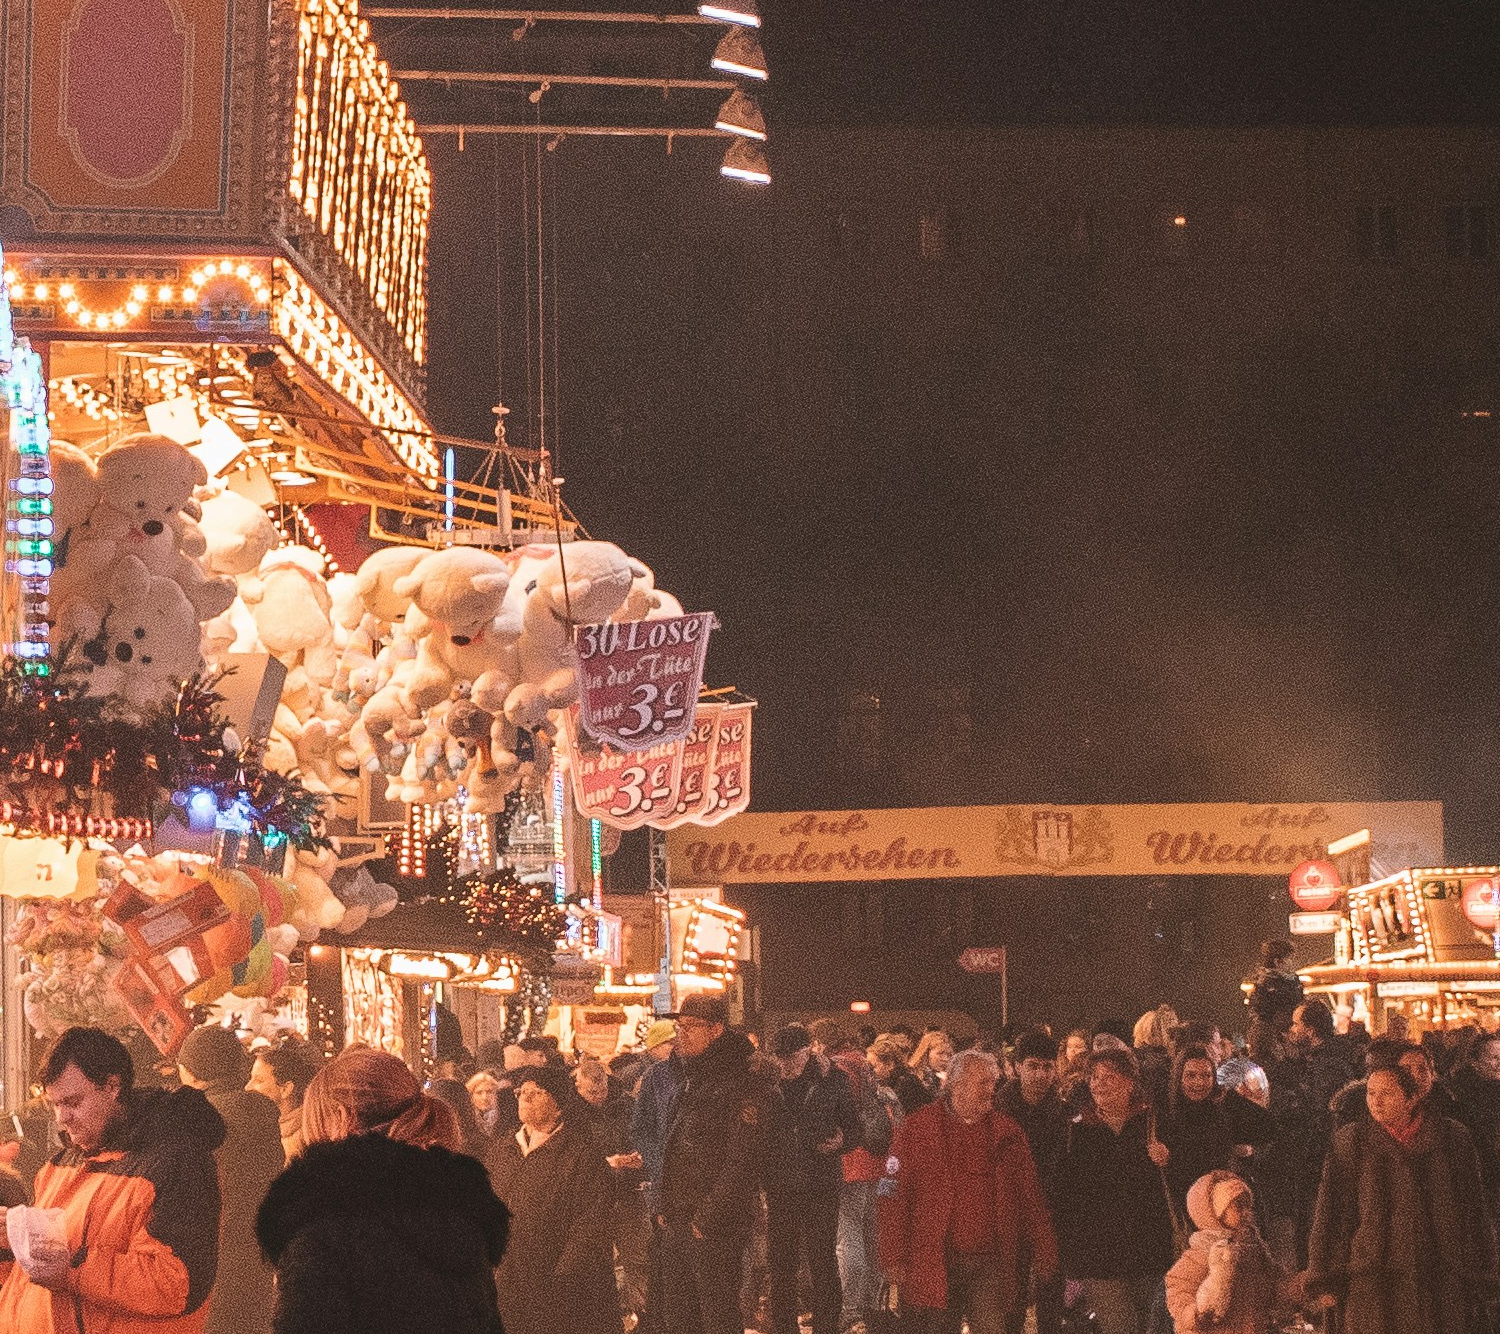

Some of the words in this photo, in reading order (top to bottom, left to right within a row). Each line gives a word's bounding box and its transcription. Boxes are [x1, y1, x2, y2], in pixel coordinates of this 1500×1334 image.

[581, 623, 621, 660] 30
[626, 616, 700, 652] Lose
[607, 665, 637, 686] der
[637, 653, 693, 681] Tüte
[591, 702, 624, 723] nur
[780, 813, 868, 835] Auf
[1240, 805, 1330, 828] Auf
[685, 835, 960, 875] Wiedersehen
[969, 952, 1000, 967] WC
